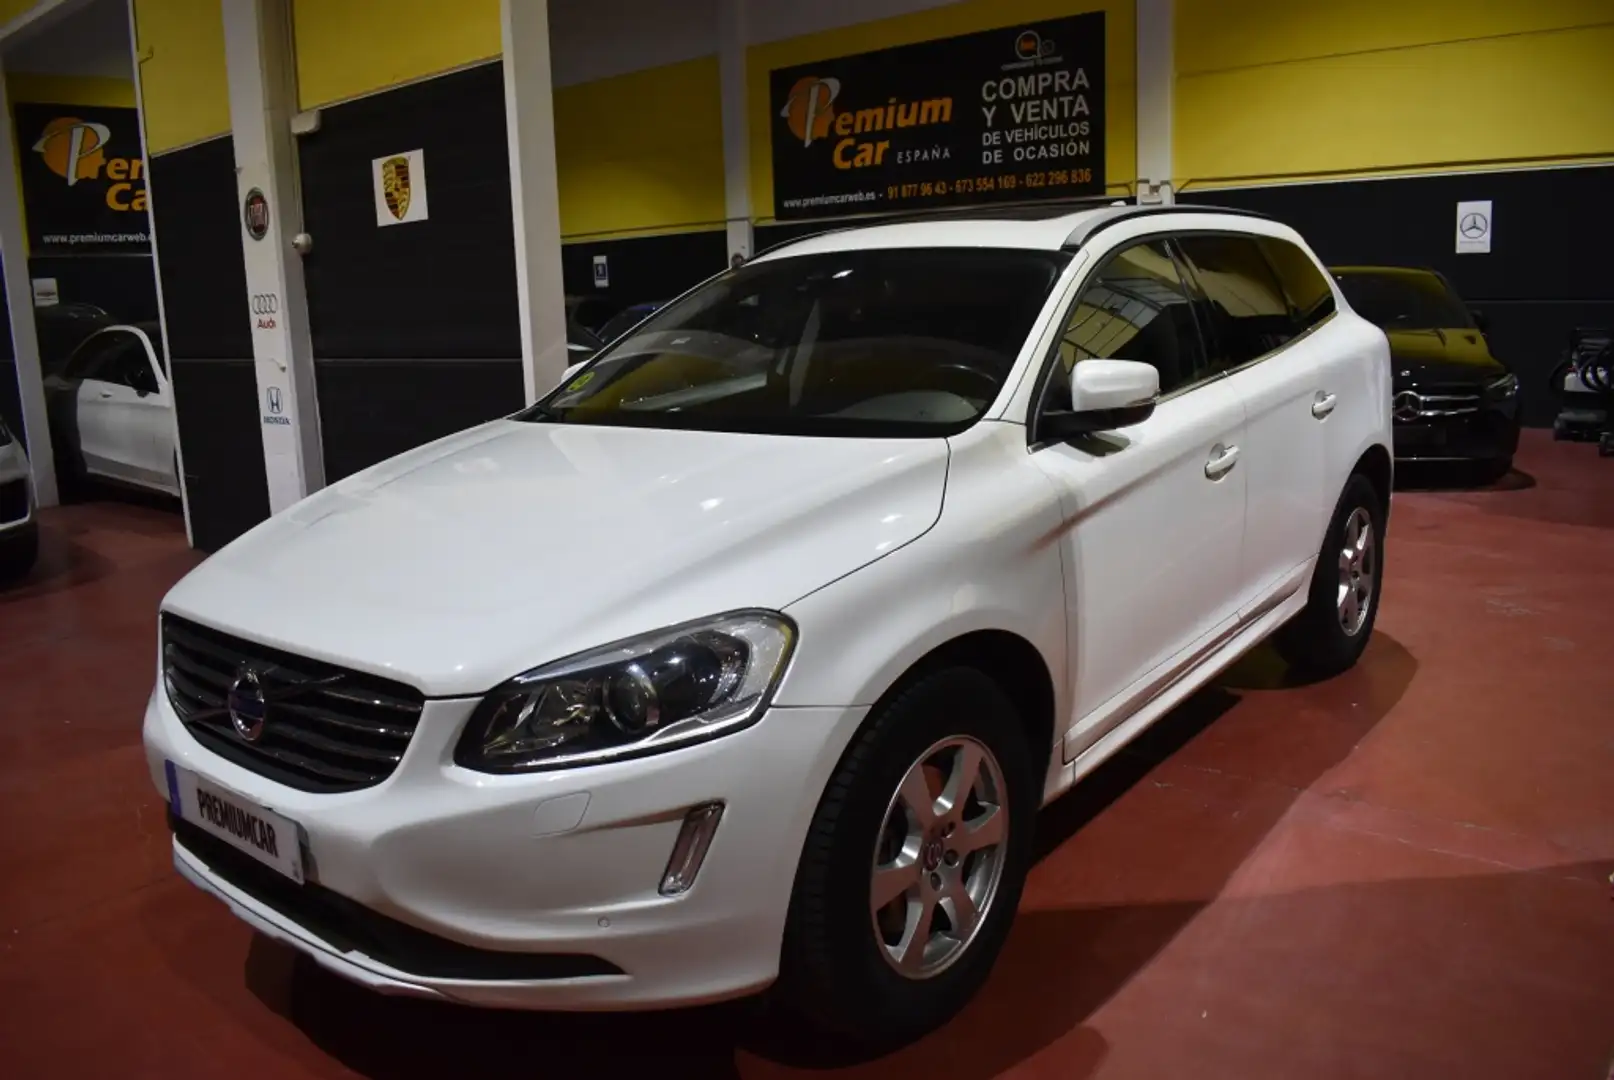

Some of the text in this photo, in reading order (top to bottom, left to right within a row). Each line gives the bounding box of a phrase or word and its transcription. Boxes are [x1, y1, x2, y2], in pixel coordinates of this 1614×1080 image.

[981, 67, 1090, 102] COMPRA
[981, 93, 1090, 128] Y VENTA
[832, 137, 951, 171] Car ESPAÑA
[982, 131, 1002, 147] DE
[982, 137, 1090, 165] DE OCASIÓN
[887, 184, 899, 201] 91
[1025, 171, 1046, 188] 622
[257, 318, 276, 329] Audi
[196, 787, 279, 858] PREMIUMCAR
